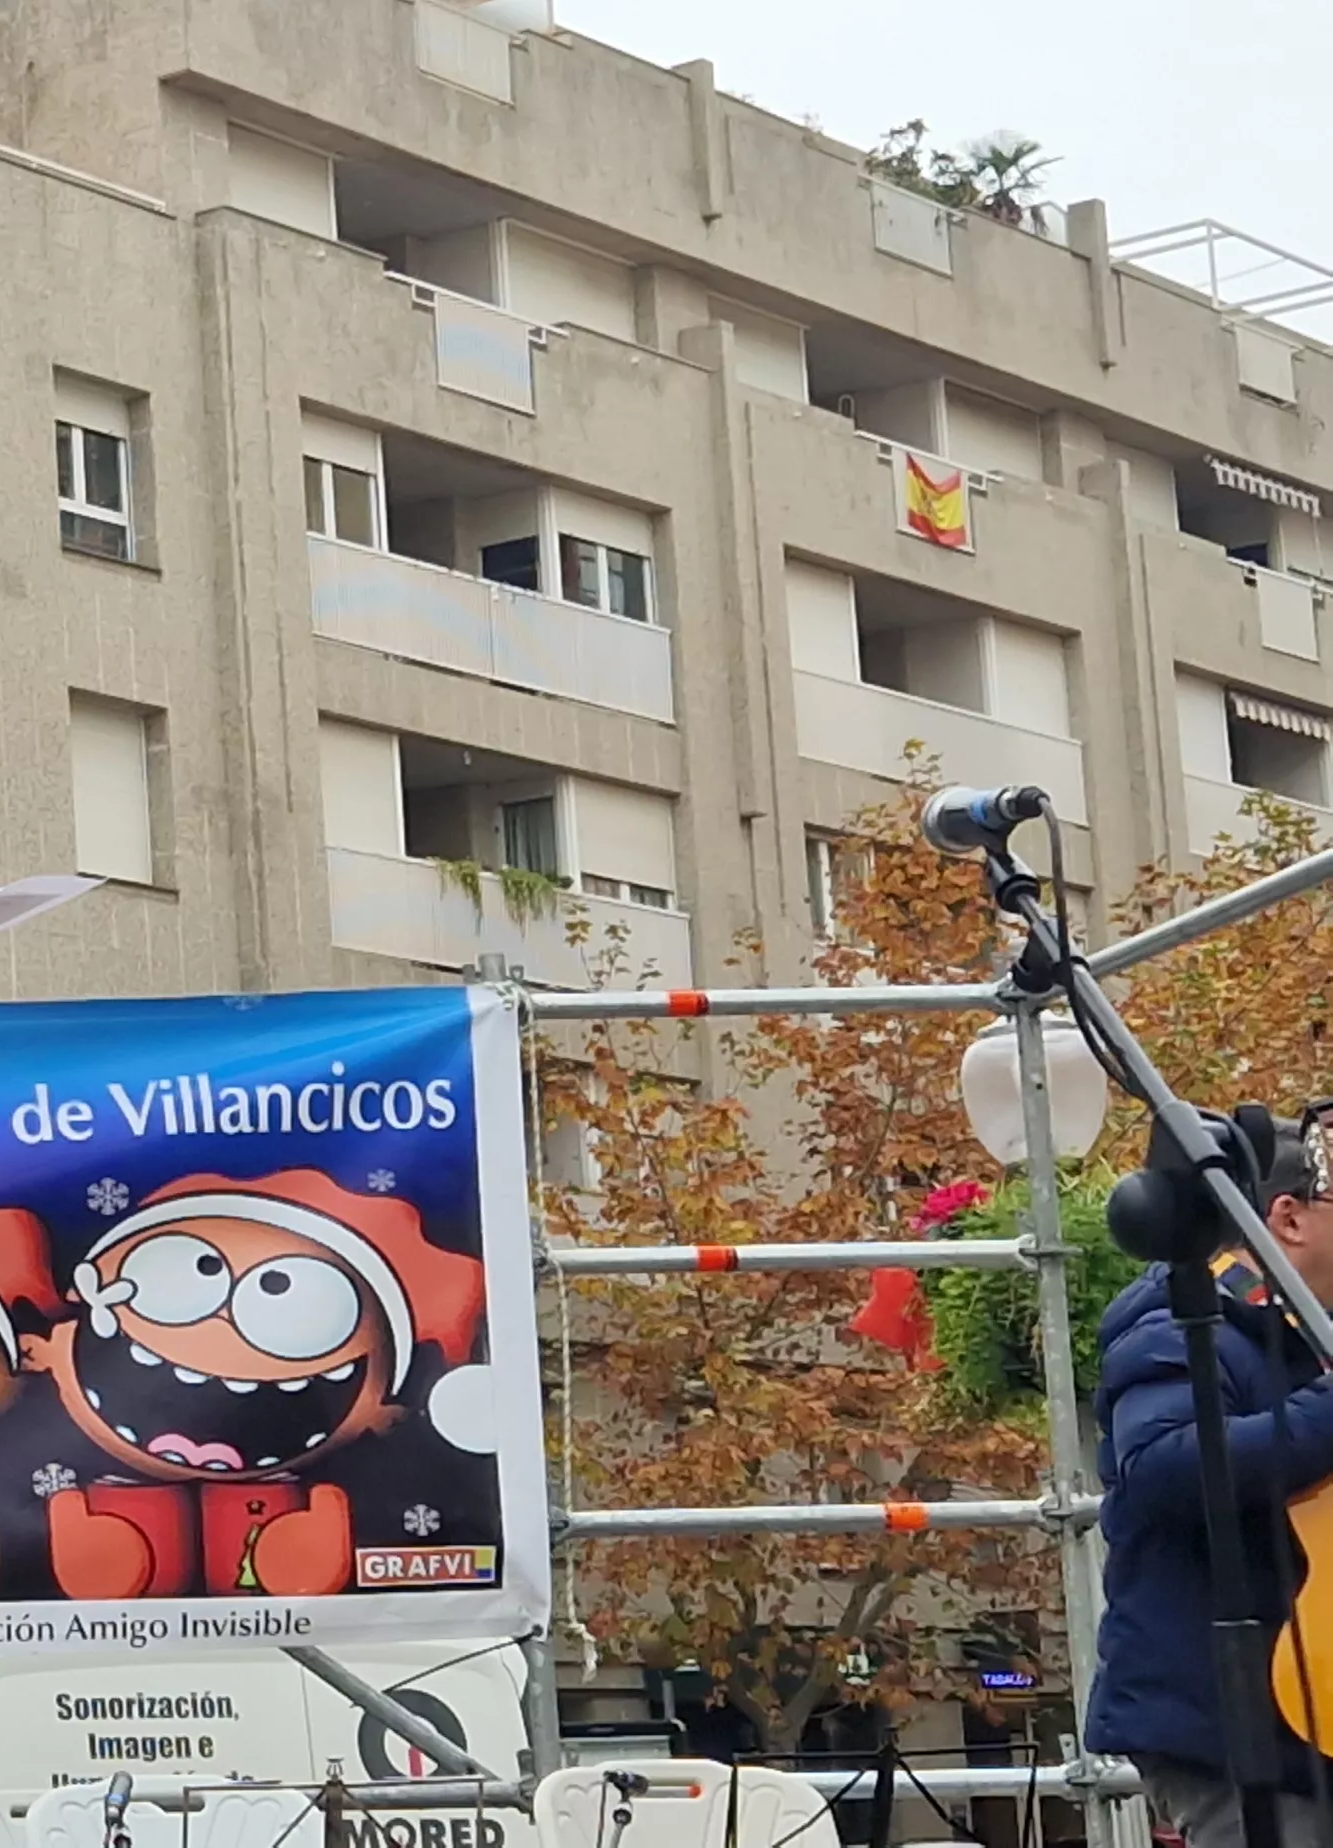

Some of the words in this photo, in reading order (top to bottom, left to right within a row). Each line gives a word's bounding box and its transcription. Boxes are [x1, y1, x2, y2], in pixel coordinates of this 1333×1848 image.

[12, 1083, 94, 1144] de
[108, 1062, 456, 1137] Villancicos
[364, 1553, 471, 1579] GRAFVI
[65, 1611, 168, 1648] Amigo
[181, 1608, 311, 1638] Invisible
[55, 1692, 240, 1721] Sonorización,
[88, 1732, 192, 1762] Imagen
[198, 1734, 214, 1758] e
